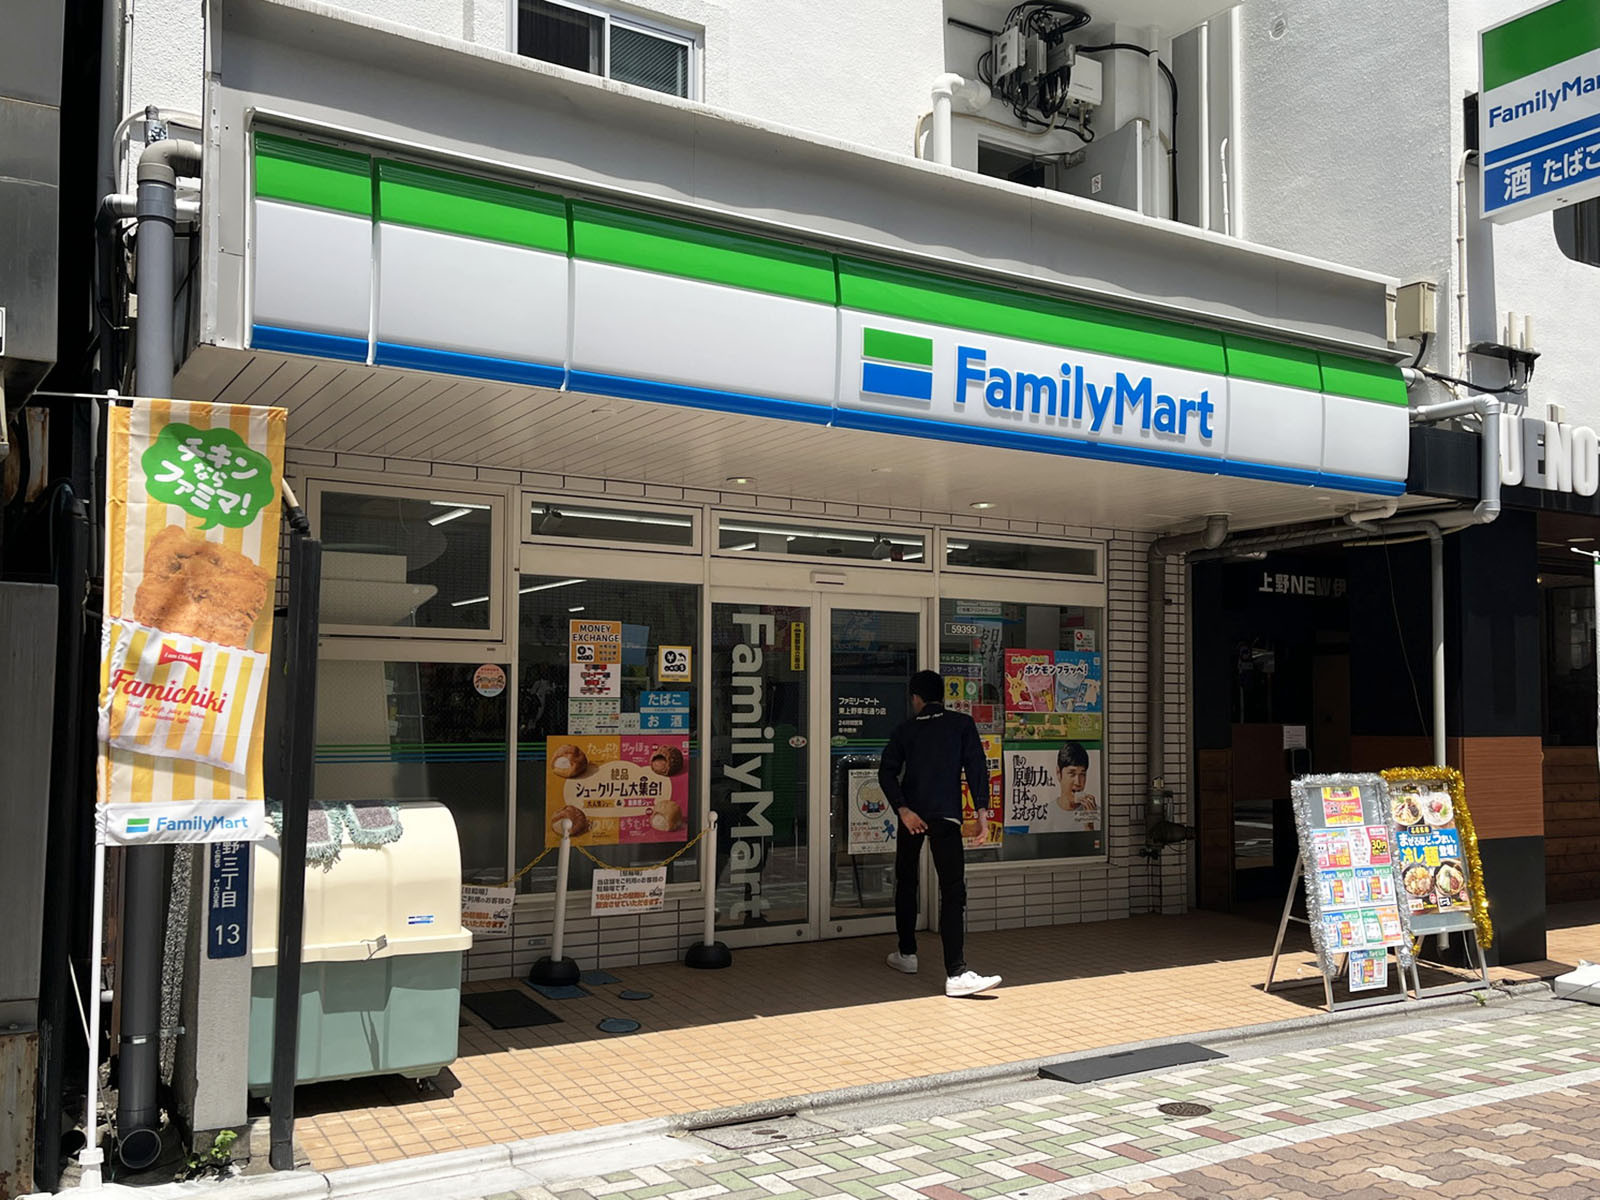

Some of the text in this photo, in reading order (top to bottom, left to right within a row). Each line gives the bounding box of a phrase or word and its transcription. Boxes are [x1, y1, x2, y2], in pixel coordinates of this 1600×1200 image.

[1503, 146, 1600, 201] 酒 たばこ
[957, 345, 1214, 439] FamilyMart
[177, 438, 258, 479] チキン
[1500, 413, 1599, 497] UENO
[193, 463, 228, 488] なら
[154, 460, 252, 516] ファミマ!
[579, 624, 611, 633] MONEY
[951, 625, 976, 634] 59393
[572, 633, 619, 643] EXCHANGE
[1025, 664, 1088, 676] ポケモンフラッペ!
[111, 669, 228, 714] Famichiki
[648, 693, 682, 706] たばこ
[838, 697, 880, 706] ファミリーマート
[648, 715, 682, 728] お酒
[611, 768, 629, 780] 絶品
[723, 613, 775, 920] FamilyMart
[576, 782, 662, 798] シュークリーム大集合!
[1013, 787, 1037, 804] 日本の
[156, 815, 248, 832] FamilyMart
[215, 923, 240, 946] 13
